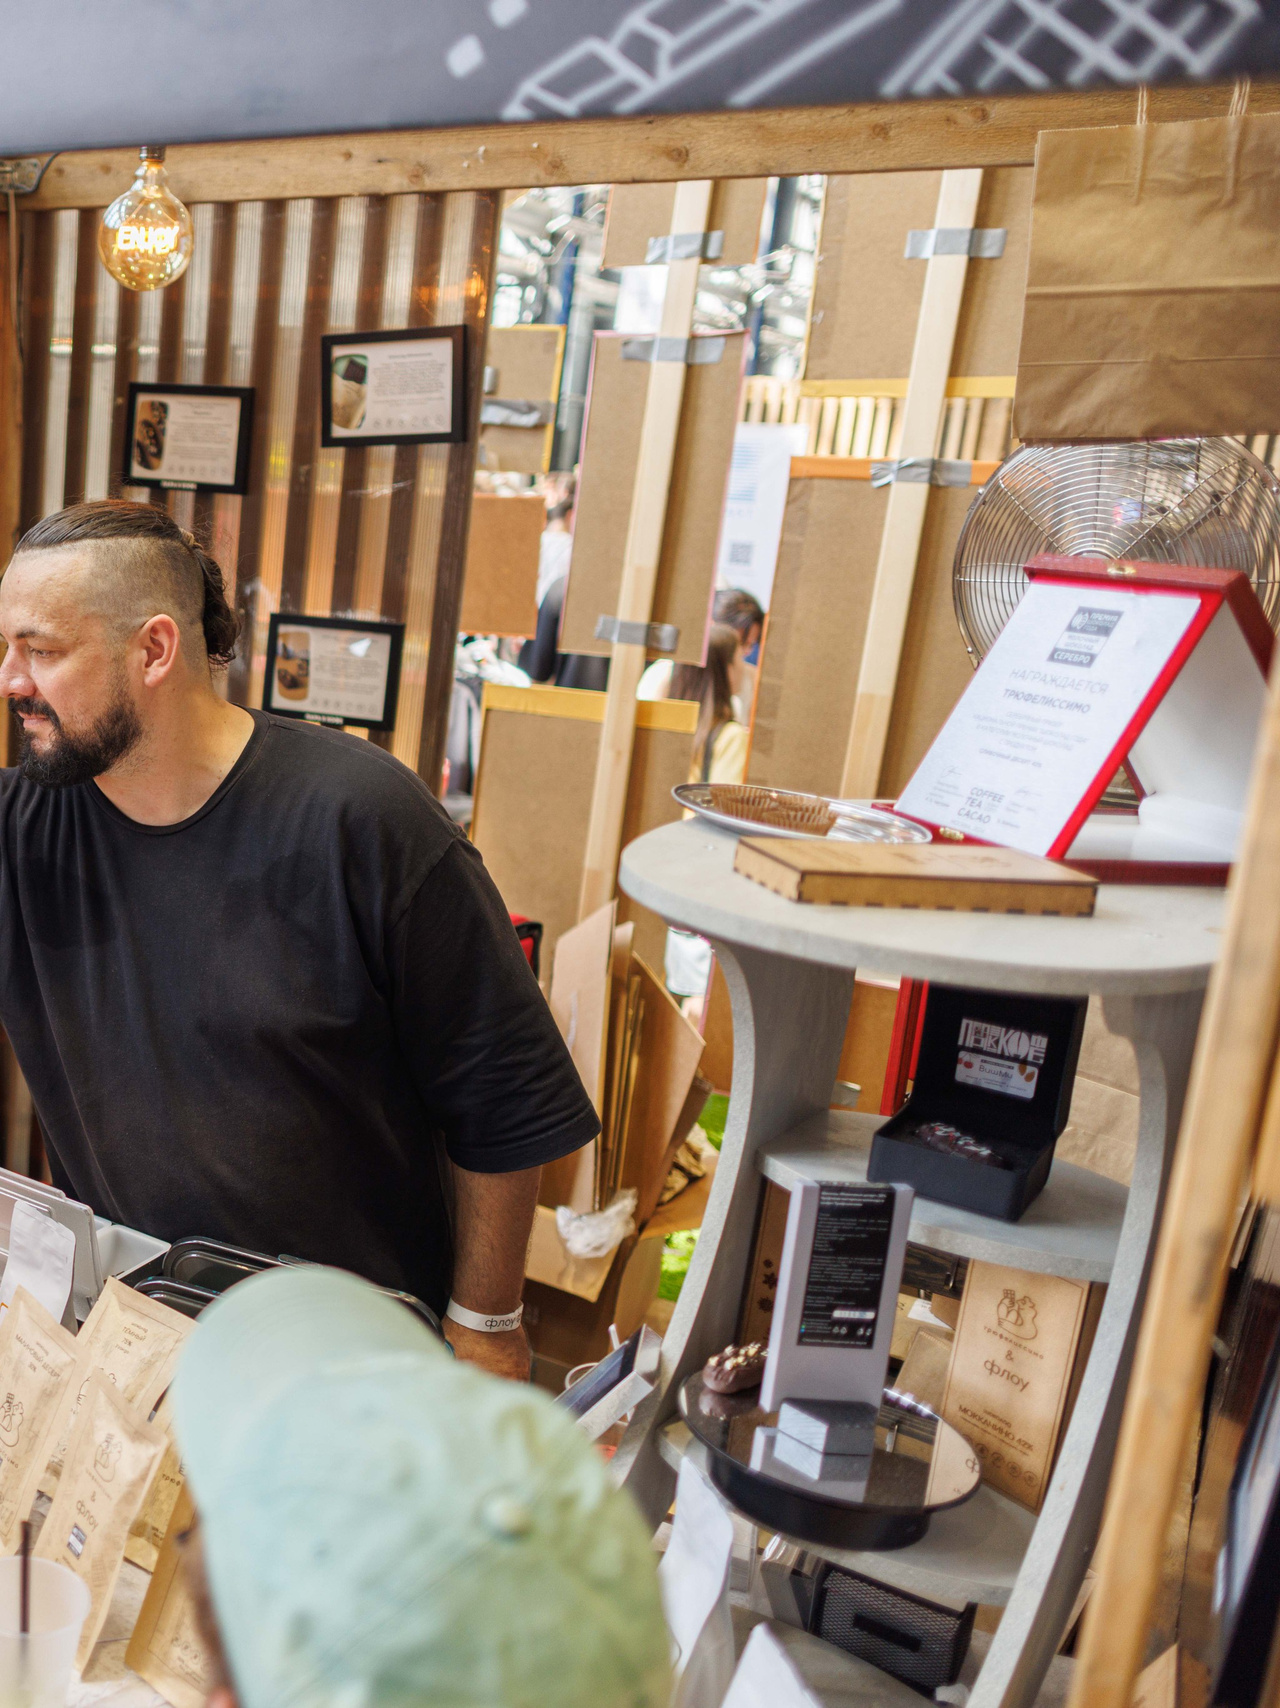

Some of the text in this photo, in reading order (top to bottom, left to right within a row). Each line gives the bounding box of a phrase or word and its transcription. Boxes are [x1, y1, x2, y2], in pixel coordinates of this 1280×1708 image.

[1053, 651, 1091, 664] СЕРЕБРО
[1009, 668, 1110, 695] НАГРАЖДАЕТСЯ
[1002, 688, 1092, 714] ТРЮФЕЛИССИМО
[964, 796, 983, 809] TEA
[969, 786, 1006, 803] COFFEE
[957, 807, 992, 824] CACAO
[484, 1318, 516, 1329] флоу
[983, 1325, 1045, 1360] трюфелиссимо
[1005, 1349, 1015, 1362] &
[983, 1359, 1030, 1393] флоу
[161, 1473, 182, 1487] трюф
[75, 1499, 100, 1533] флоу
